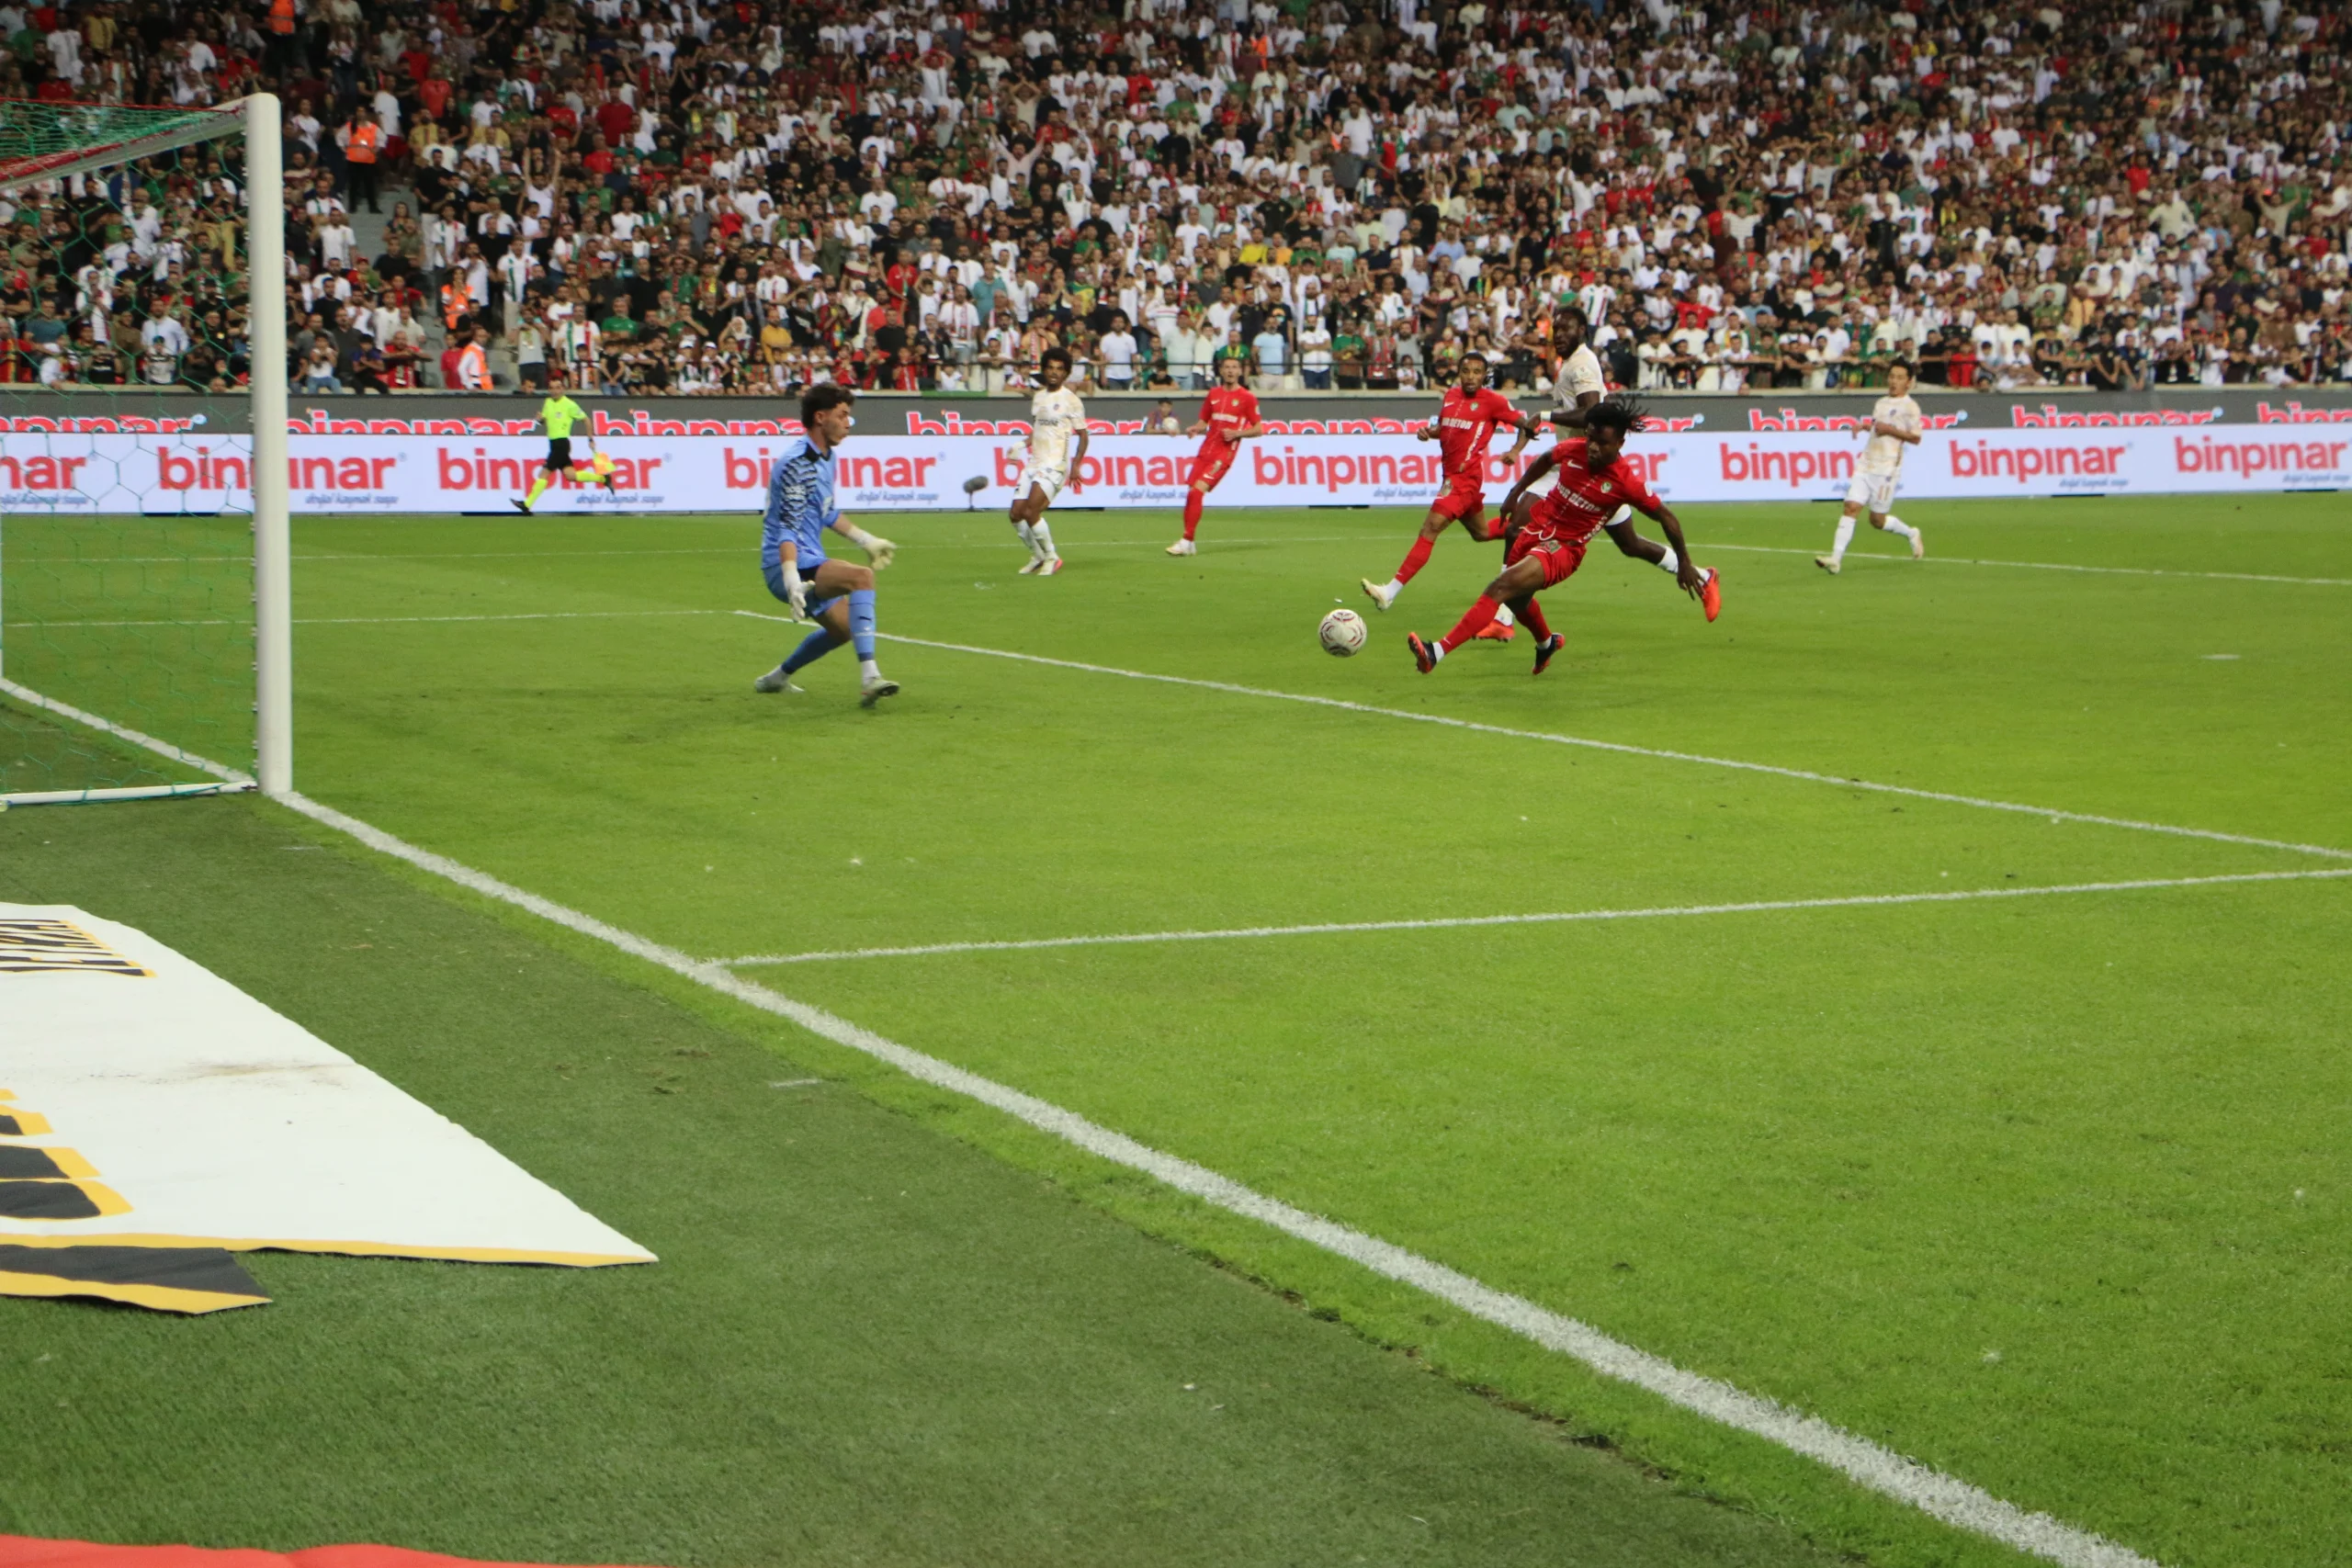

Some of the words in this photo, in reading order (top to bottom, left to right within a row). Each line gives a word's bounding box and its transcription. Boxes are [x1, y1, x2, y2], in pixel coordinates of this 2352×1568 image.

[1720, 443, 1862, 488] binpın
[1950, 440, 2125, 483] binpınar
[2174, 435, 2349, 479] binpınar
